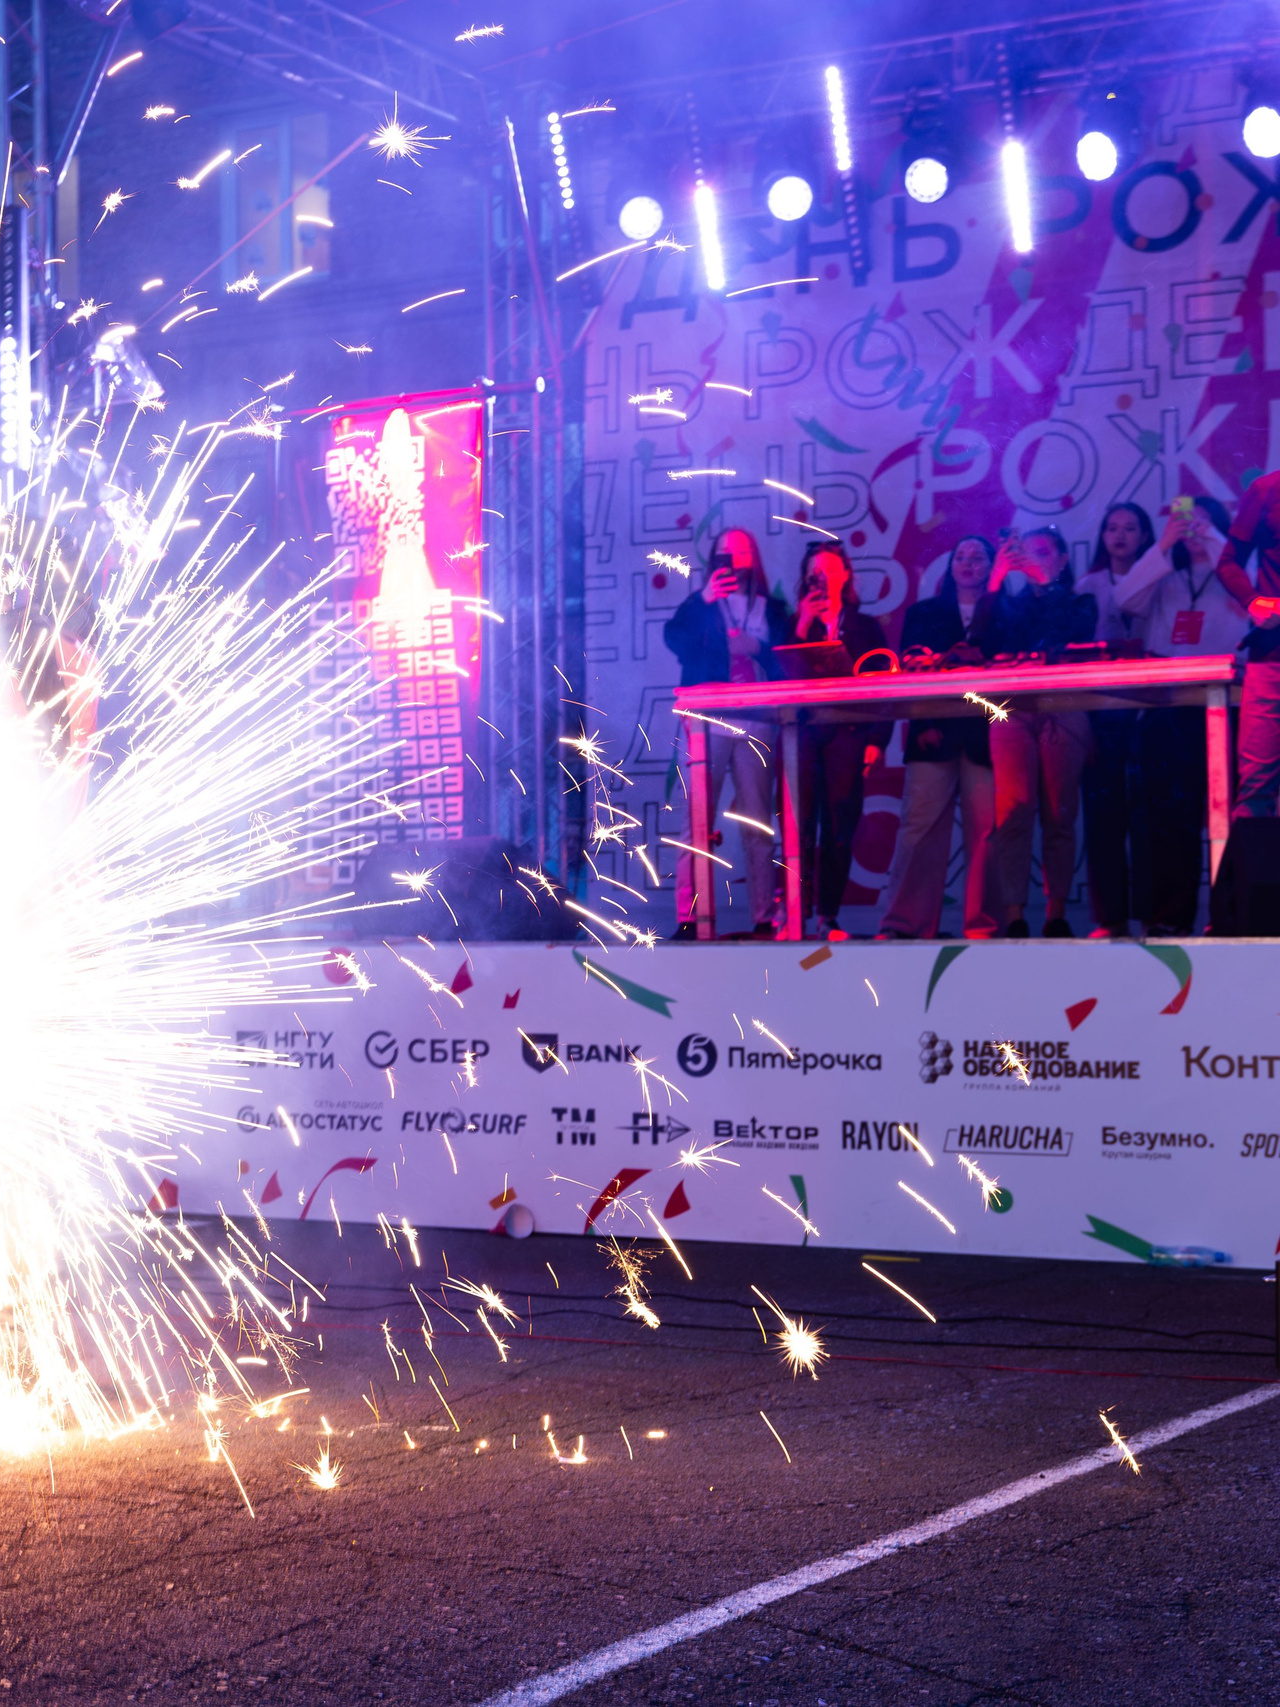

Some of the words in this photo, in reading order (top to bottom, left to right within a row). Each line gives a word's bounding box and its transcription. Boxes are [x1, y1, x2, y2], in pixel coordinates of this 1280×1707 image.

[744, 270, 1280, 421] РОЖДЕ
[274, 1030, 334, 1048] НГТУ
[408, 1038, 490, 1064] СБЕР
[566, 1044, 642, 1063] BANK
[728, 1046, 883, 1076] Пятёрочка
[842, 1120, 918, 1152] RAYON
[958, 1124, 1064, 1150] HARUCHA
[1102, 1126, 1214, 1150] Безумно.
[1240, 1133, 1280, 1159] SPO
